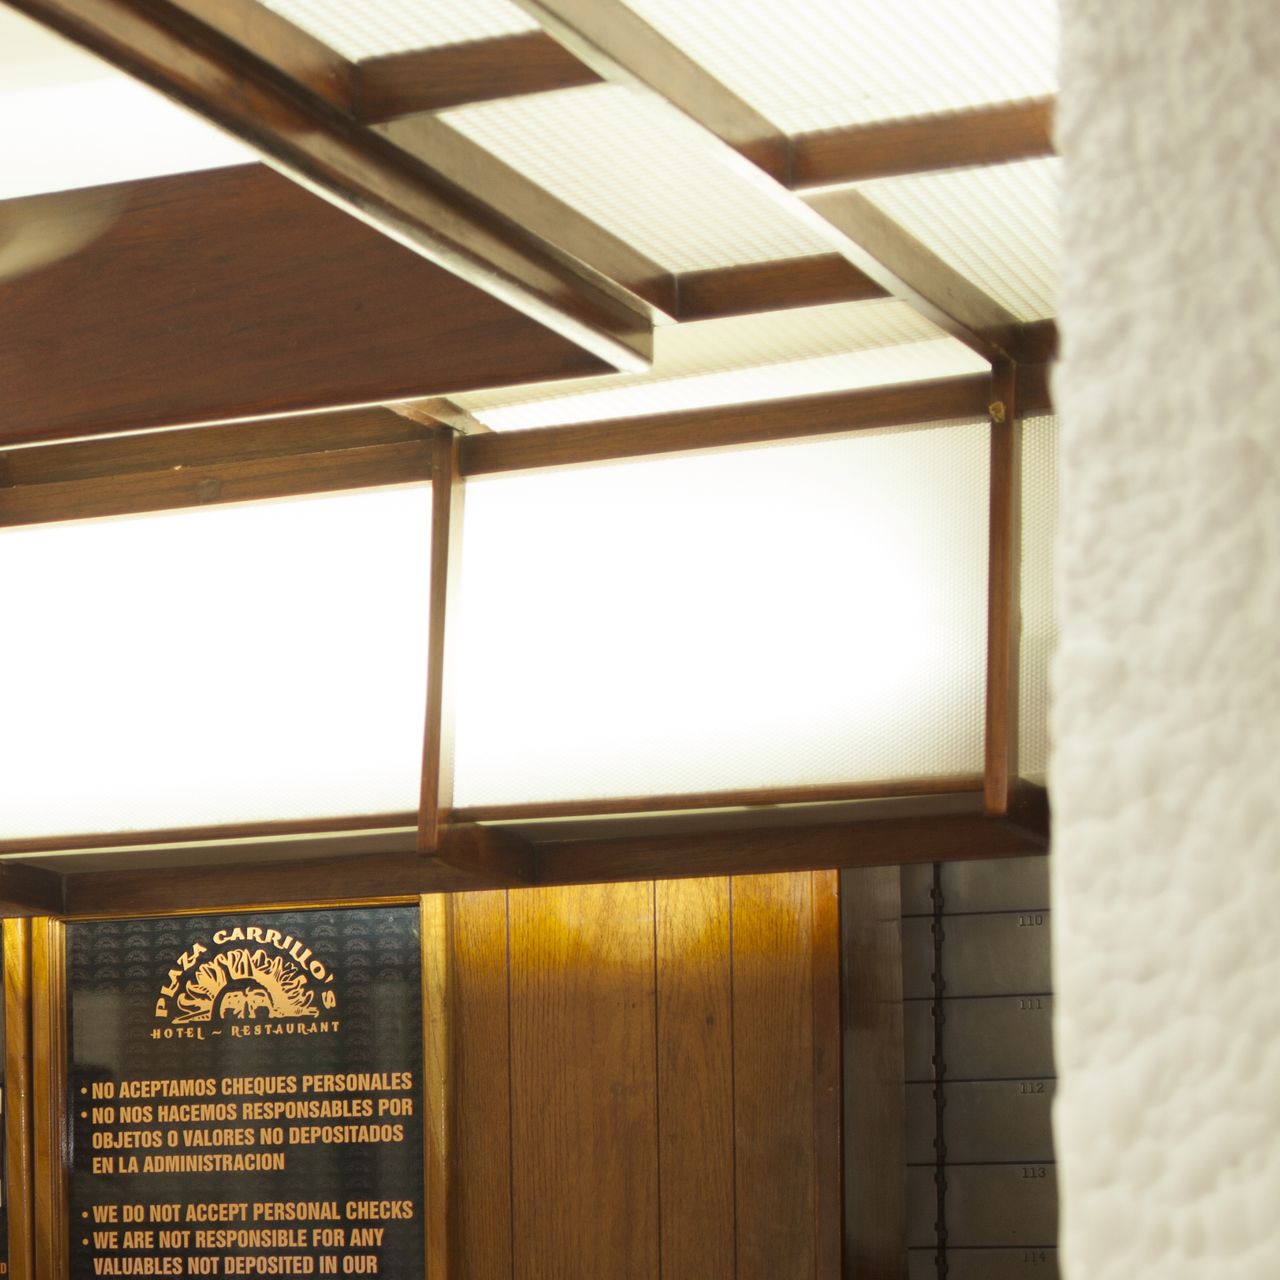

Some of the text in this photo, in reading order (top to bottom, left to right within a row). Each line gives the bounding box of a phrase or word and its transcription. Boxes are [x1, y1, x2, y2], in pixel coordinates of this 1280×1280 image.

[1019, 915, 1043, 926] 110
[155, 926, 337, 1018] PLAZA CARRILLO'S
[1020, 999, 1043, 1010] 111
[150, 1021, 340, 1040] HOTEL RESTAURANT
[92, 1072, 413, 1099] NO ACEPTAMOS CHEQUES PERSONALES
[1020, 1083, 1044, 1094] 112
[92, 1098, 413, 1124] NO NOS HACEMOS RESPONSABLES POR
[92, 1124, 404, 1149] OBJETOS O VALORES NO DEPOSITADOS
[92, 1153, 285, 1174] EN LA ADMINISTRACION
[1022, 1167, 1046, 1178] 113
[92, 1200, 413, 1223] WE DO NOT ACCEPT PERSONAL CHECKS
[93, 1228, 384, 1249] WE ARE NOT RESPONSIBLE FOR ANY
[93, 1255, 378, 1275] VALUABLES NOT DEPOSITED IN OUR
[1023, 1251, 1046, 1263] 114
